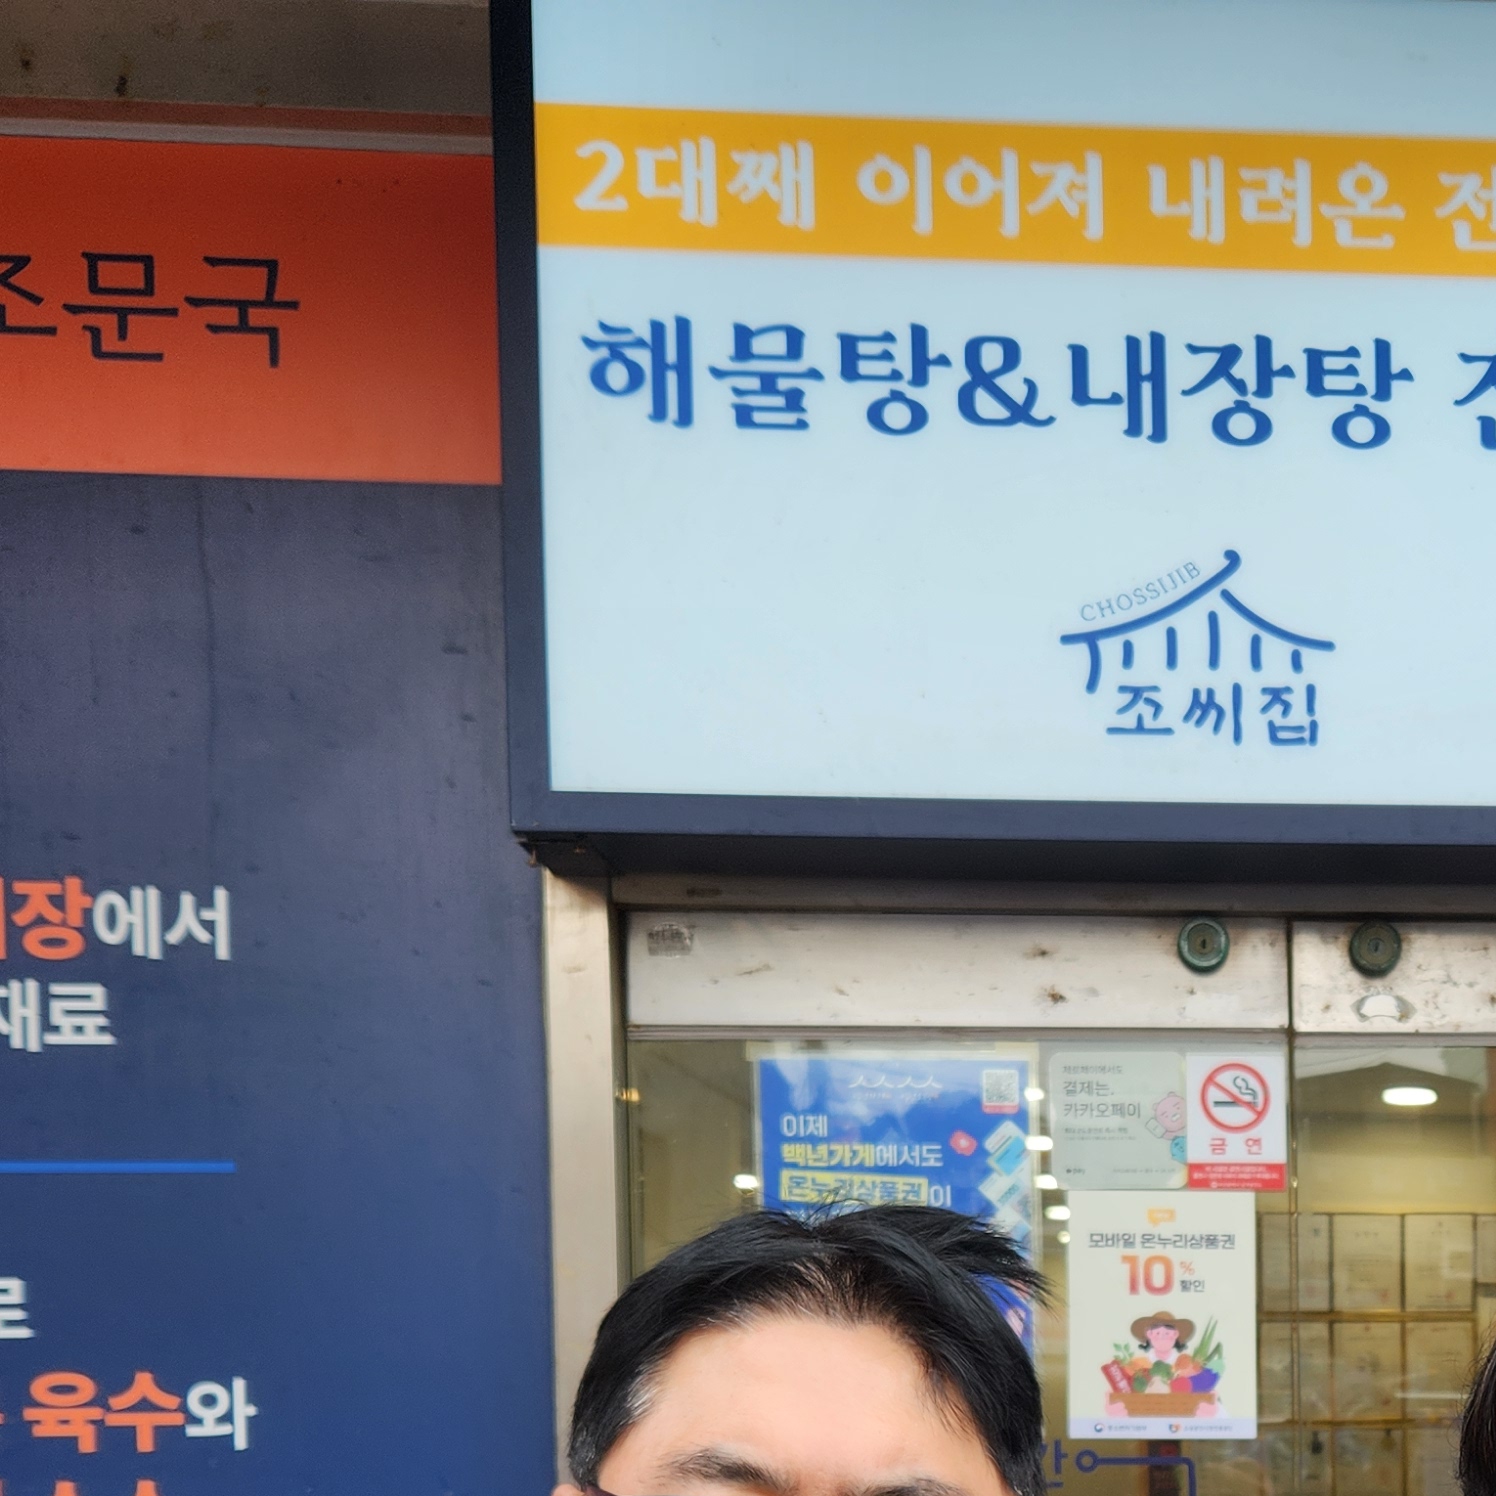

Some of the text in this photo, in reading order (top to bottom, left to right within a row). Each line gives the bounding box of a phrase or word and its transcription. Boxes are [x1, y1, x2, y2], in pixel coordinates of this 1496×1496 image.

[573, 136, 816, 231] 2대째
[856, 143, 1104, 241] 이어져
[1148, 154, 1406, 249] 내려온
[580, 314, 1414, 449] 해물탕&내장탕
[1079, 561, 1201, 622] CHOSSIJIB
[1106, 682, 1319, 747] 조씨집
[0, 875, 231, 960] 장에서
[782, 1115, 828, 1137] 이제
[1064, 1102, 1141, 1119] 카카오페이
[781, 1143, 943, 1167] 백년가게에서도
[1088, 1233, 1235, 1249] 모바일 온누리상품권
[1180, 1280, 1205, 1292] 할인
[23, 1370, 259, 1453] 육수와
